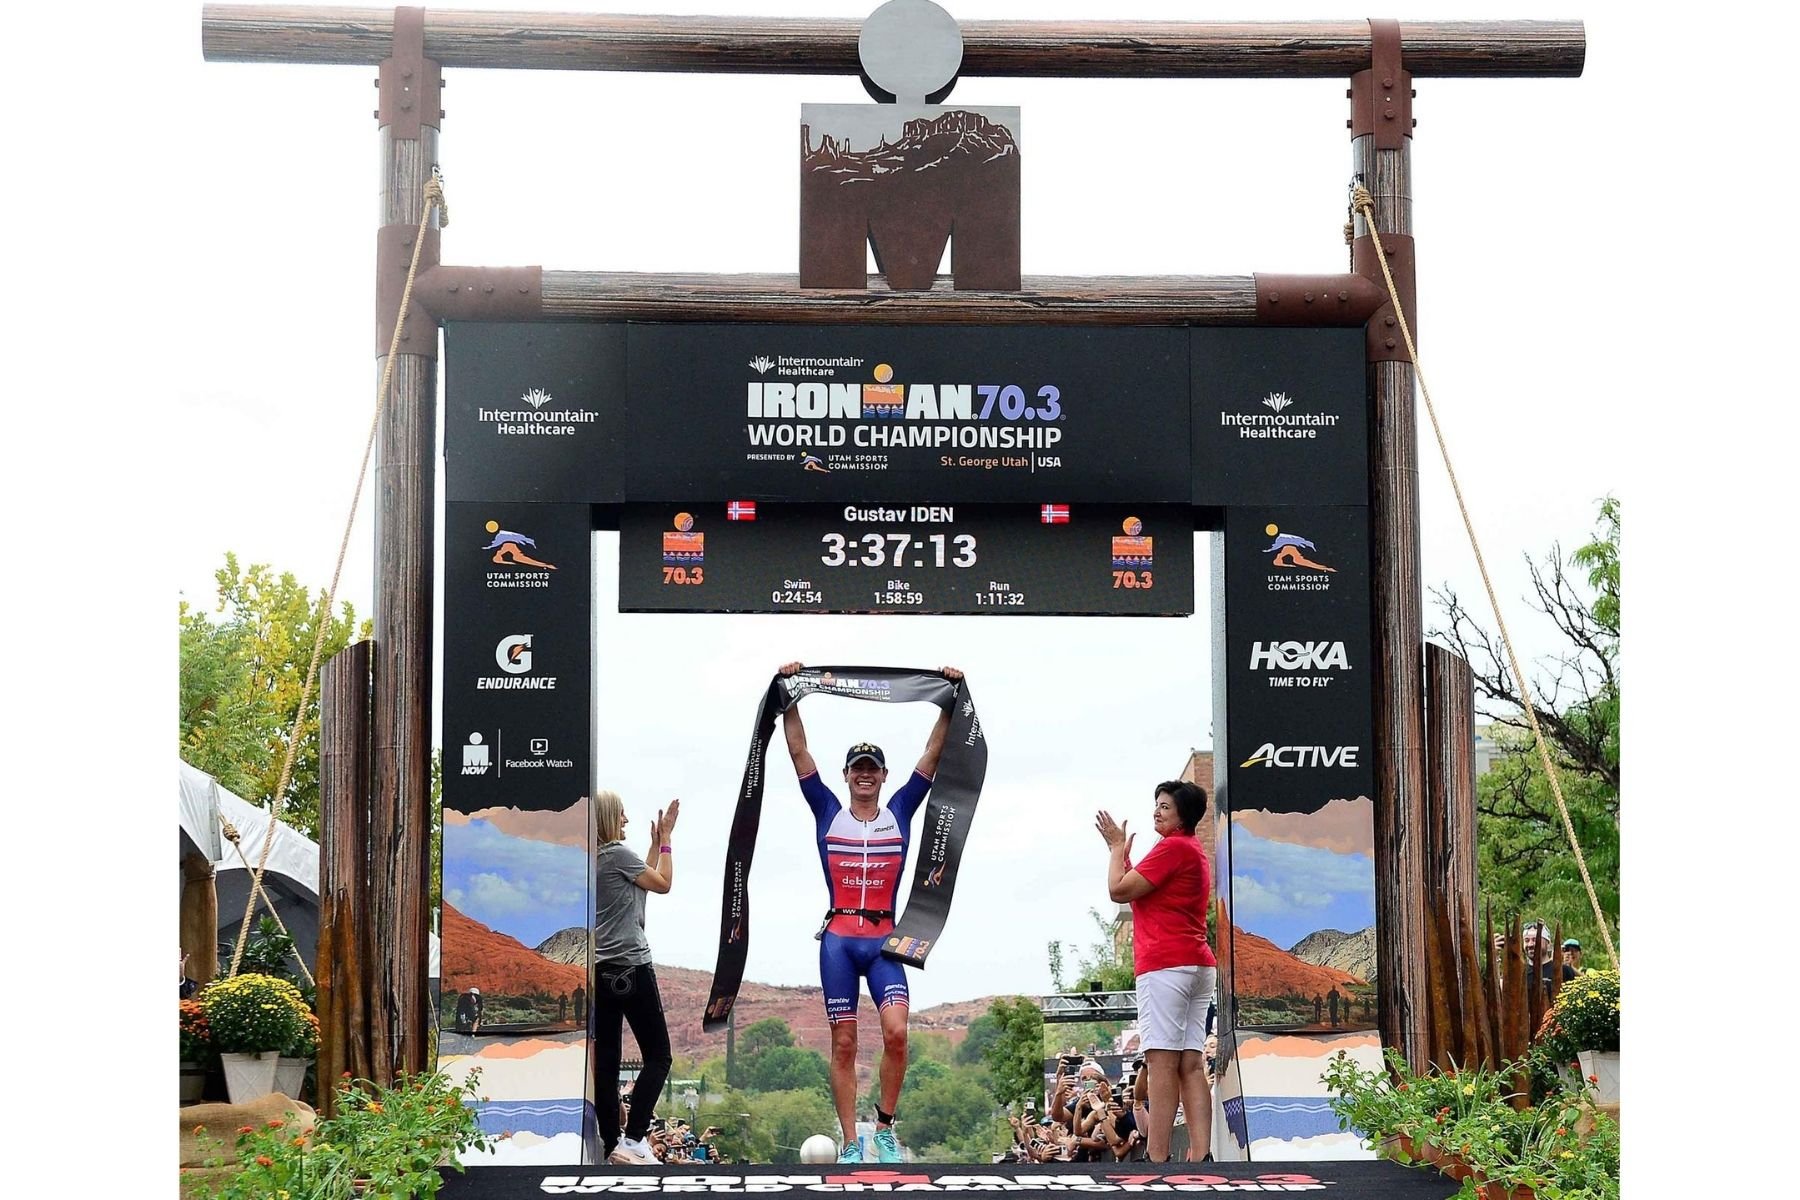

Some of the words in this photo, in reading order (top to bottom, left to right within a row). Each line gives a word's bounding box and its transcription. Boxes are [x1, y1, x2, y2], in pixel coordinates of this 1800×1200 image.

[778, 355, 861, 367] Intermountain
[778, 367, 834, 376] Healthcare
[977, 384, 1061, 421] 70.3
[478, 407, 596, 424] Intermountain
[1220, 411, 1335, 427] Intermountain
[498, 423, 575, 436] Healthcare
[747, 424, 846, 446] WORLD
[854, 425, 1062, 448] CHAMPIONSHIP
[1239, 426, 1317, 439] Healthcare
[828, 454, 851, 462] UTAH
[940, 456, 956, 467] St.
[959, 456, 999, 469] George
[1002, 456, 1029, 467] Utah
[1037, 456, 1062, 467] USA
[828, 462, 888, 470] COMMISSION
[844, 506, 906, 523] Gustav
[911, 507, 954, 523] IDEN
[820, 532, 977, 568] 3:37:13
[662, 567, 704, 585] 70.3
[1112, 571, 1153, 589] 70.3
[783, 578, 811, 590] Swim
[887, 580, 910, 591] Bike
[989, 581, 1010, 592] Run
[1268, 583, 1329, 591] COMMISSION
[772, 591, 822, 604] 0:24:54
[874, 592, 923, 605] 1:58:59
[975, 593, 1024, 606] 1:11:32
[1249, 641, 1349, 670] HOKA
[477, 677, 556, 689] ENDURANCE
[1269, 677, 1294, 687] TIME
[1296, 677, 1311, 687] TO
[1313, 677, 1329, 687] FLY
[819, 684, 891, 696] CHAMPIONSHIP
[1240, 742, 1359, 767] ACTIVE
[506, 759, 544, 768] Facebook
[546, 759, 573, 768] Watch
[461, 767, 488, 775] NOW
[931, 839, 940, 861] UTAH
[936, 805, 949, 836] SPORTS
[938, 807, 956, 862] COMMISSION
[842, 875, 885, 886] deboer
[912, 940, 930, 960] 70.3
[540, 1184, 793, 1194] WORLD
